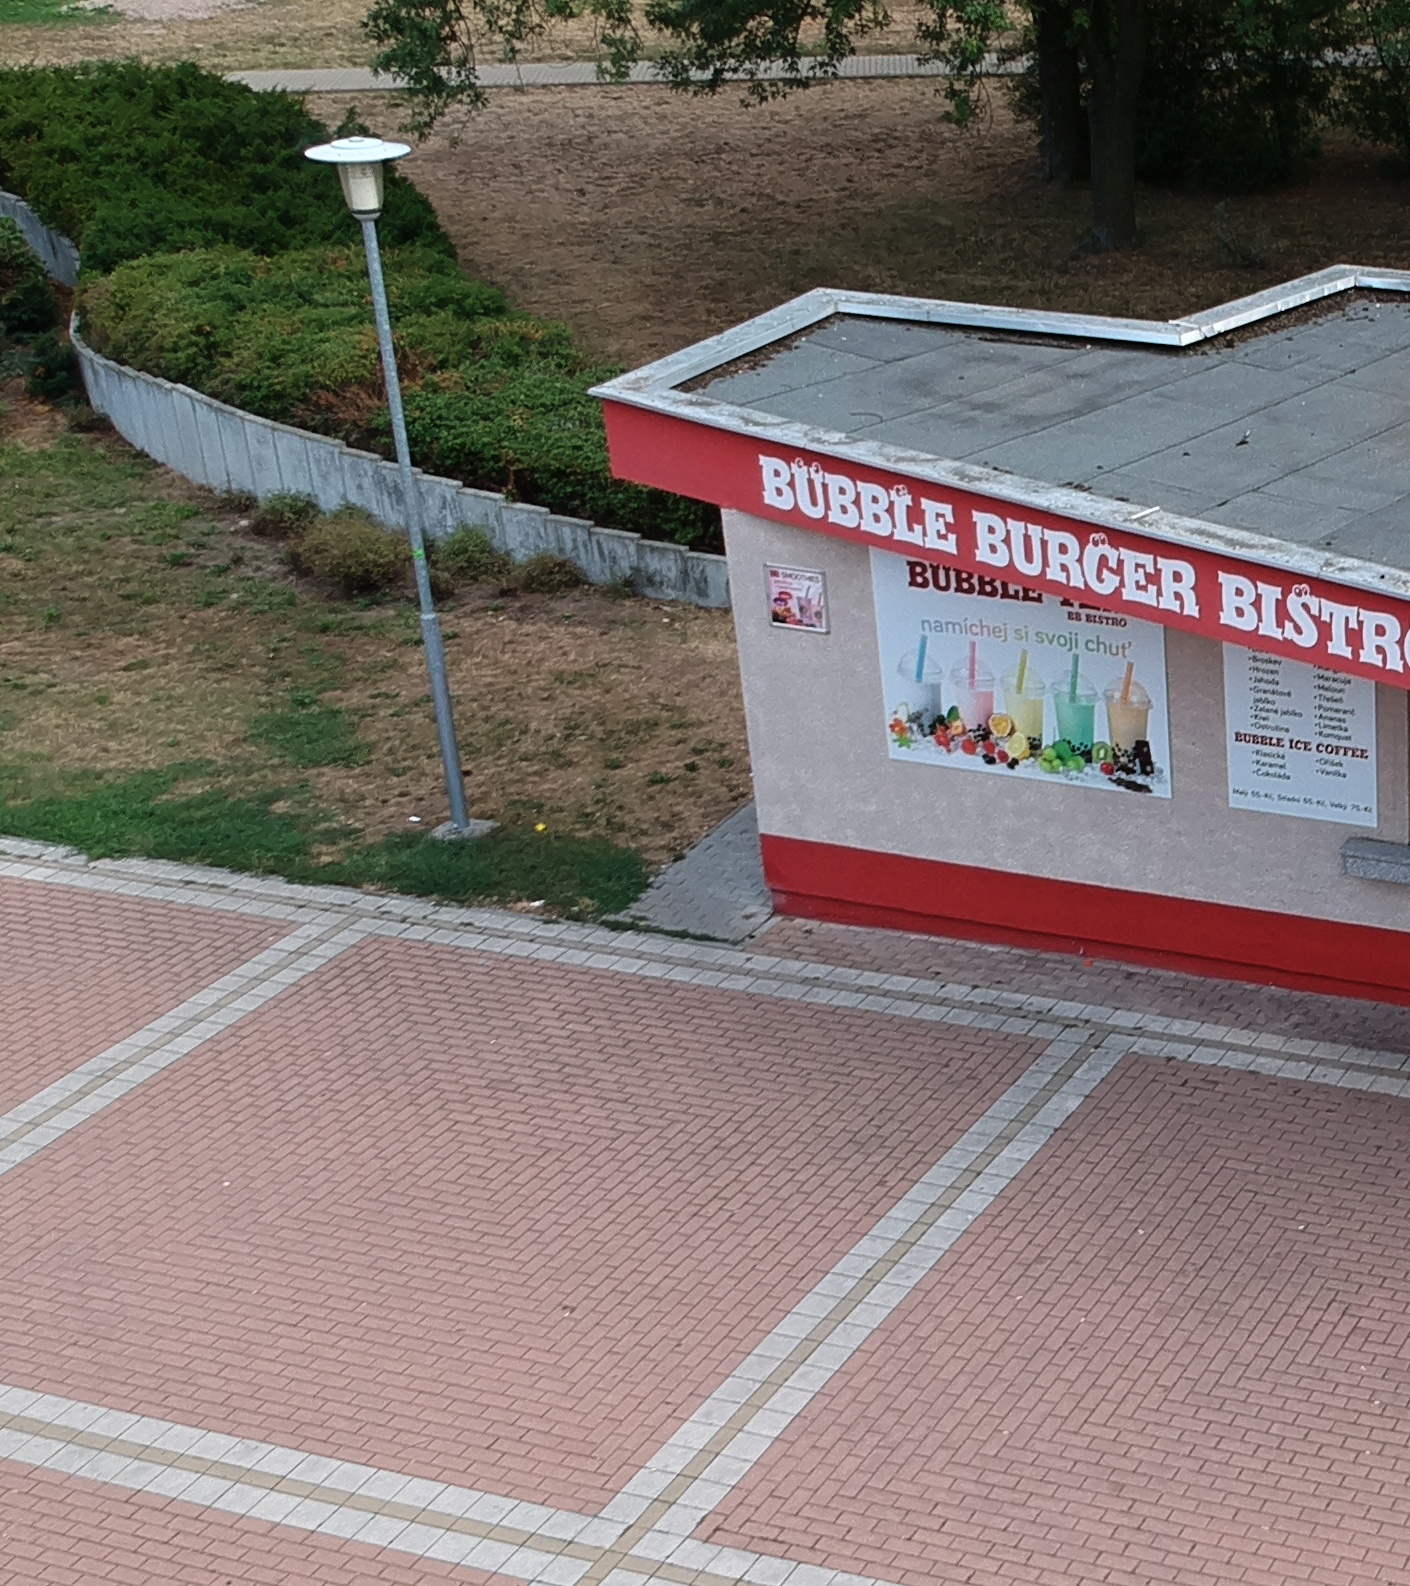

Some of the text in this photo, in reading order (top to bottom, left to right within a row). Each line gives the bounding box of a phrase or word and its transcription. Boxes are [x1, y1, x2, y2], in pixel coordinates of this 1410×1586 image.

[758, 454, 957, 555] BUBBLE
[972, 510, 1200, 619] BURGER
[921, 616, 1008, 642] namíchej
[1014, 625, 1029, 642] si
[1035, 631, 1079, 652] svoji
[1085, 613, 1127, 628] BISTRO
[1234, 732, 1369, 759] BUBBLE ICE COFFEE
